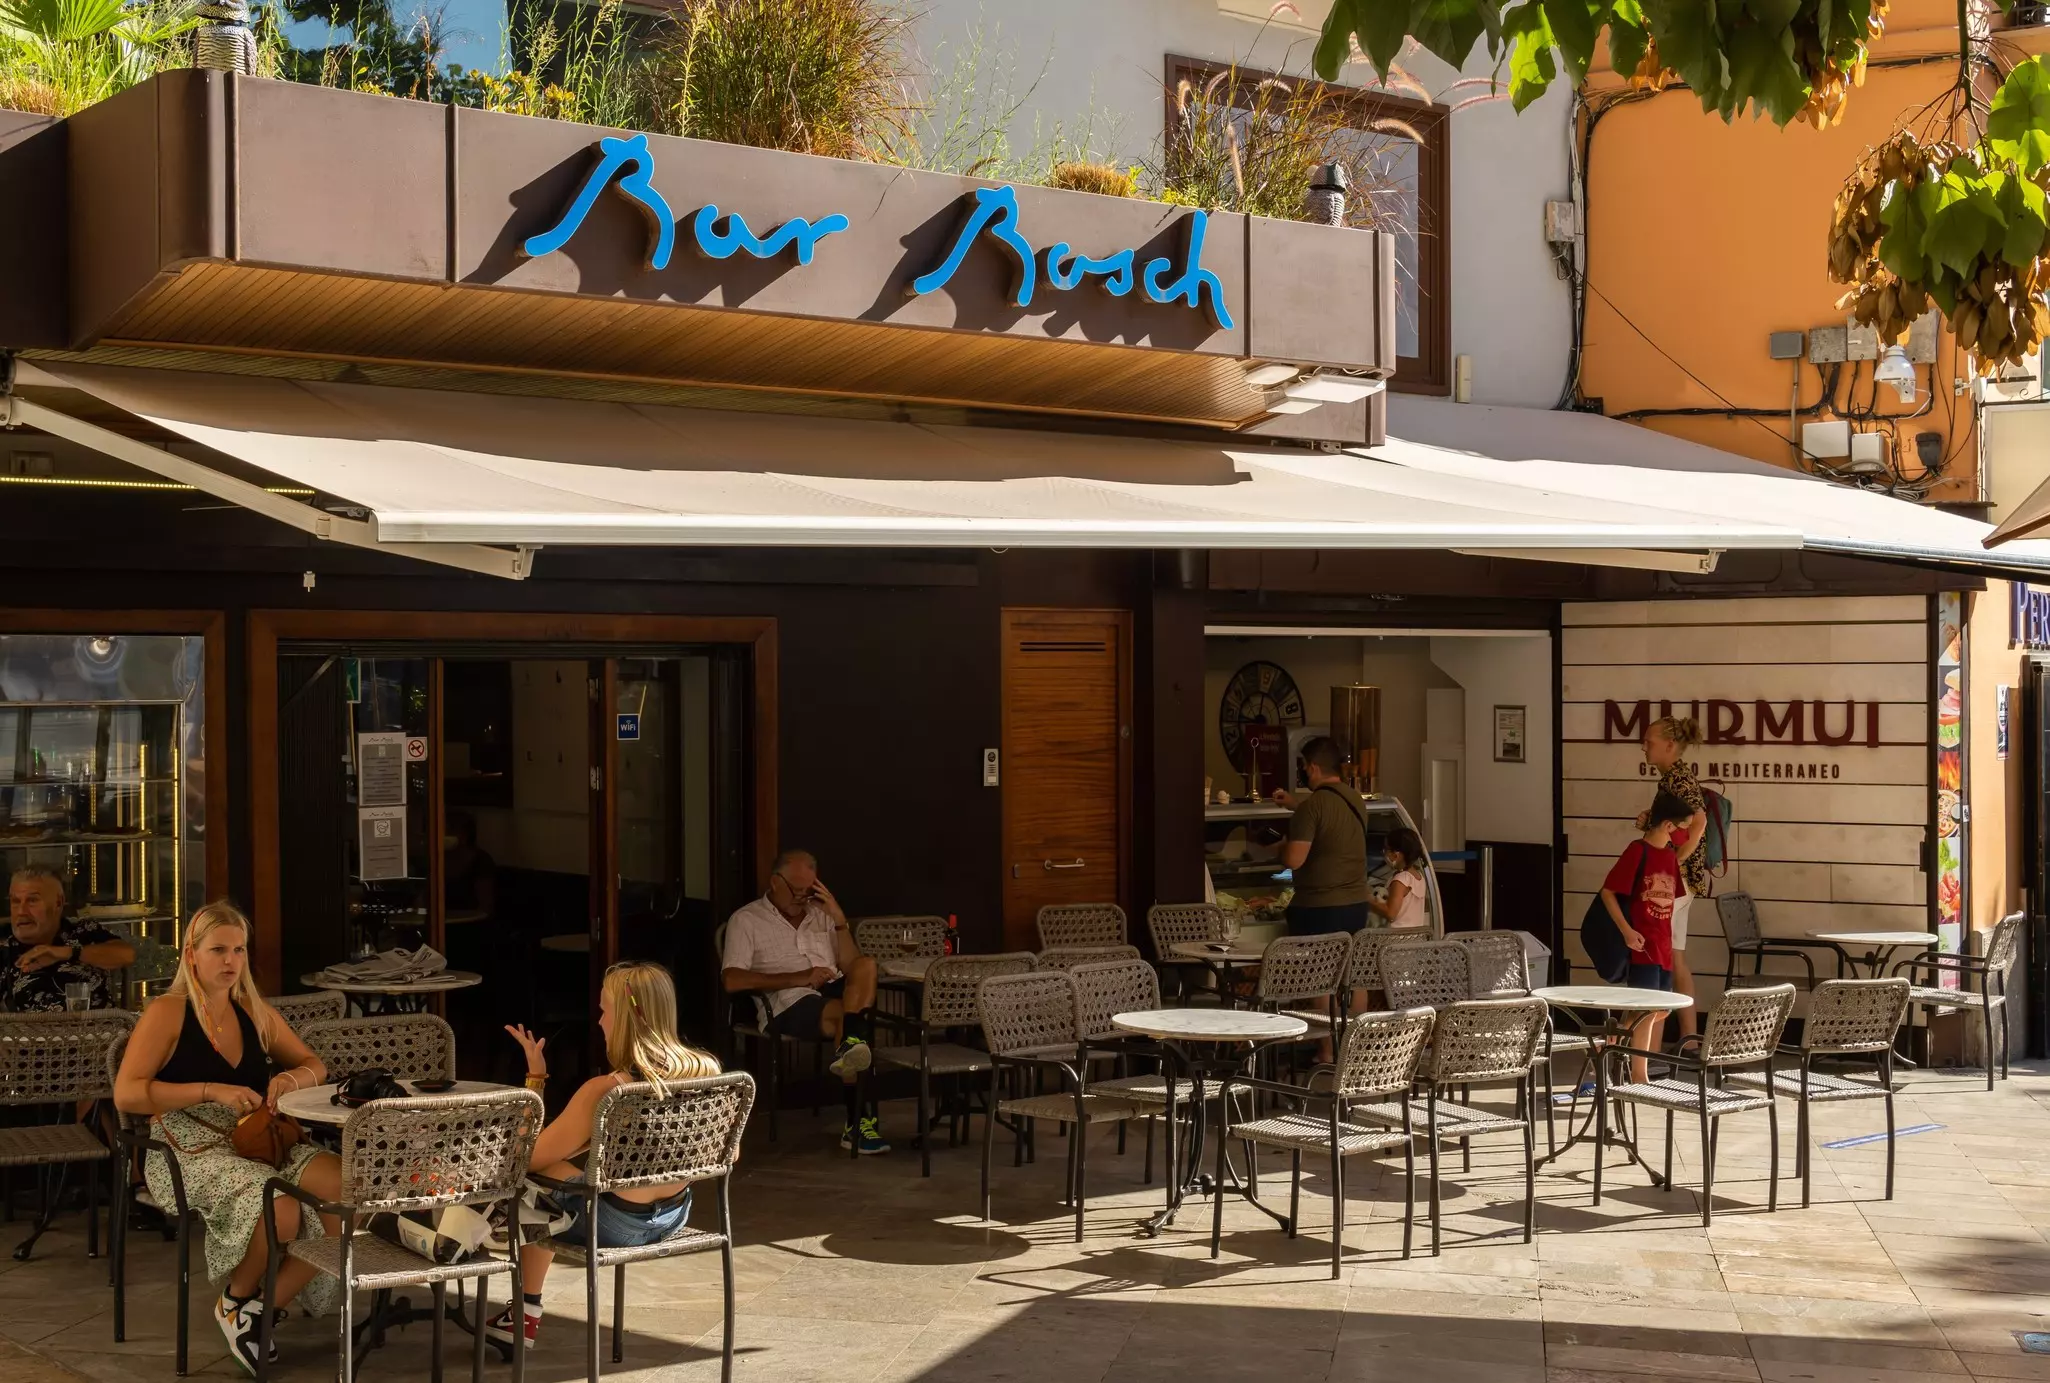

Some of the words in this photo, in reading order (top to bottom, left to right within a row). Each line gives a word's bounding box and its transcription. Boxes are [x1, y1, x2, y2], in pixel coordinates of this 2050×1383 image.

[525, 134, 849, 271] Bar
[914, 186, 1235, 330] Bosch
[1639, 762, 1699, 777] GEO
[1709, 763, 1840, 779] MEDITERRANEO
